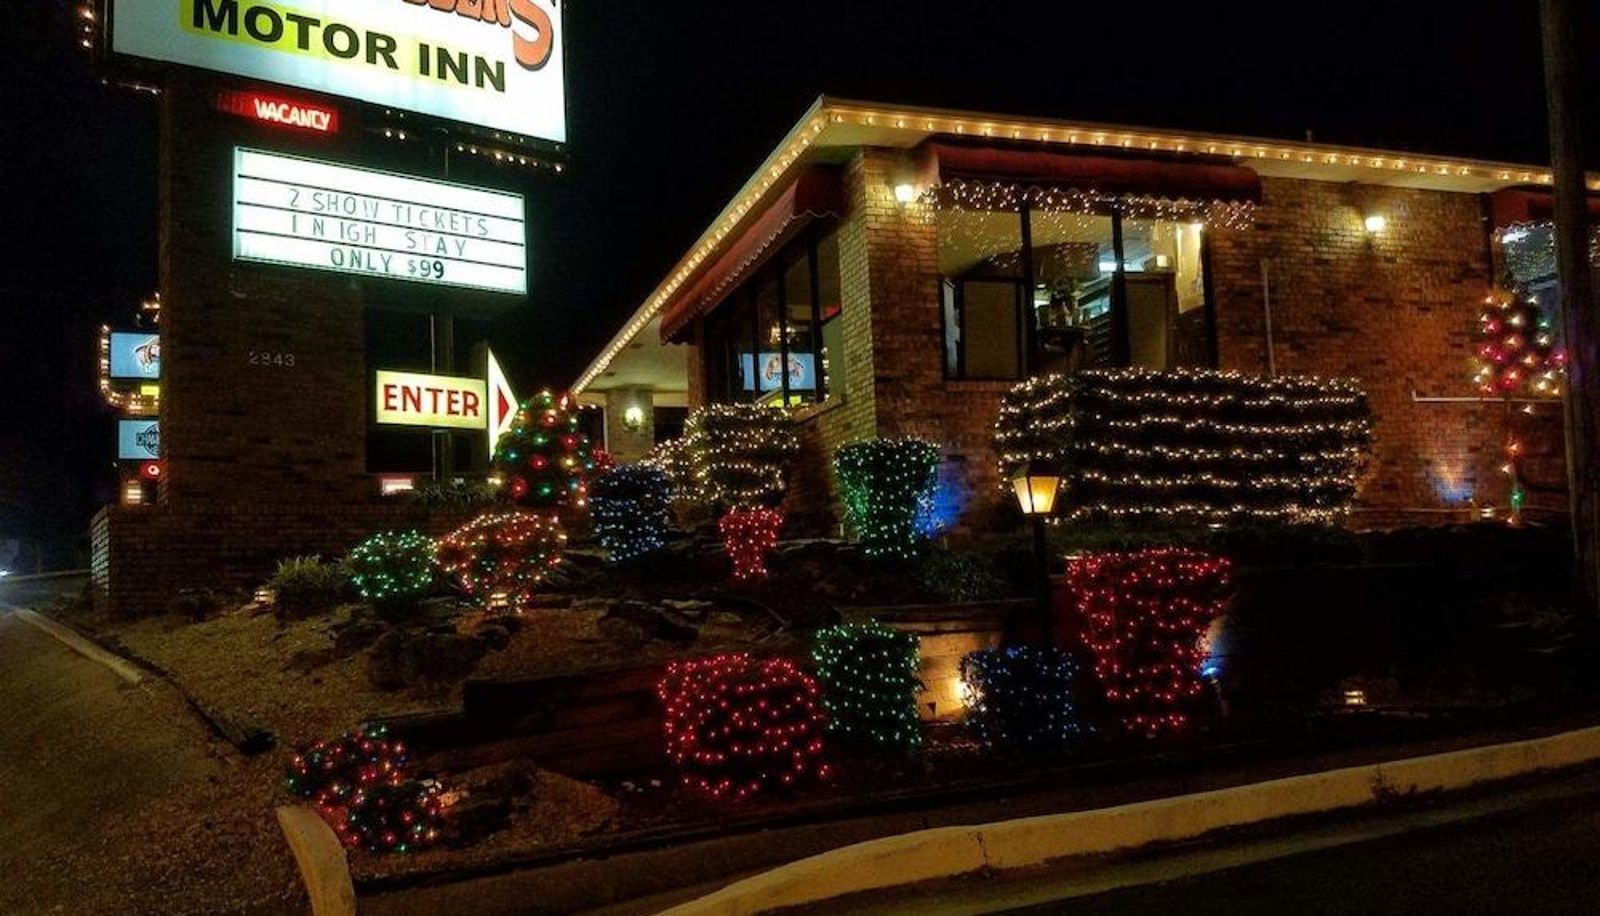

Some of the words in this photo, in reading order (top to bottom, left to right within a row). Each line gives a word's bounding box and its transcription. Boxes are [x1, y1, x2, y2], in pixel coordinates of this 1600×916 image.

[192, 0, 400, 70] MOTOR
[419, 42, 506, 93] INN
[254, 97, 332, 132] VACANCY
[288, 187, 300, 208] 2
[312, 192, 379, 219] SHOW
[391, 203, 489, 236] TICKETS
[404, 230, 467, 257] STAY
[330, 247, 393, 273] ONLY
[407, 259, 445, 280] $99
[383, 383, 480, 418] ENTER
